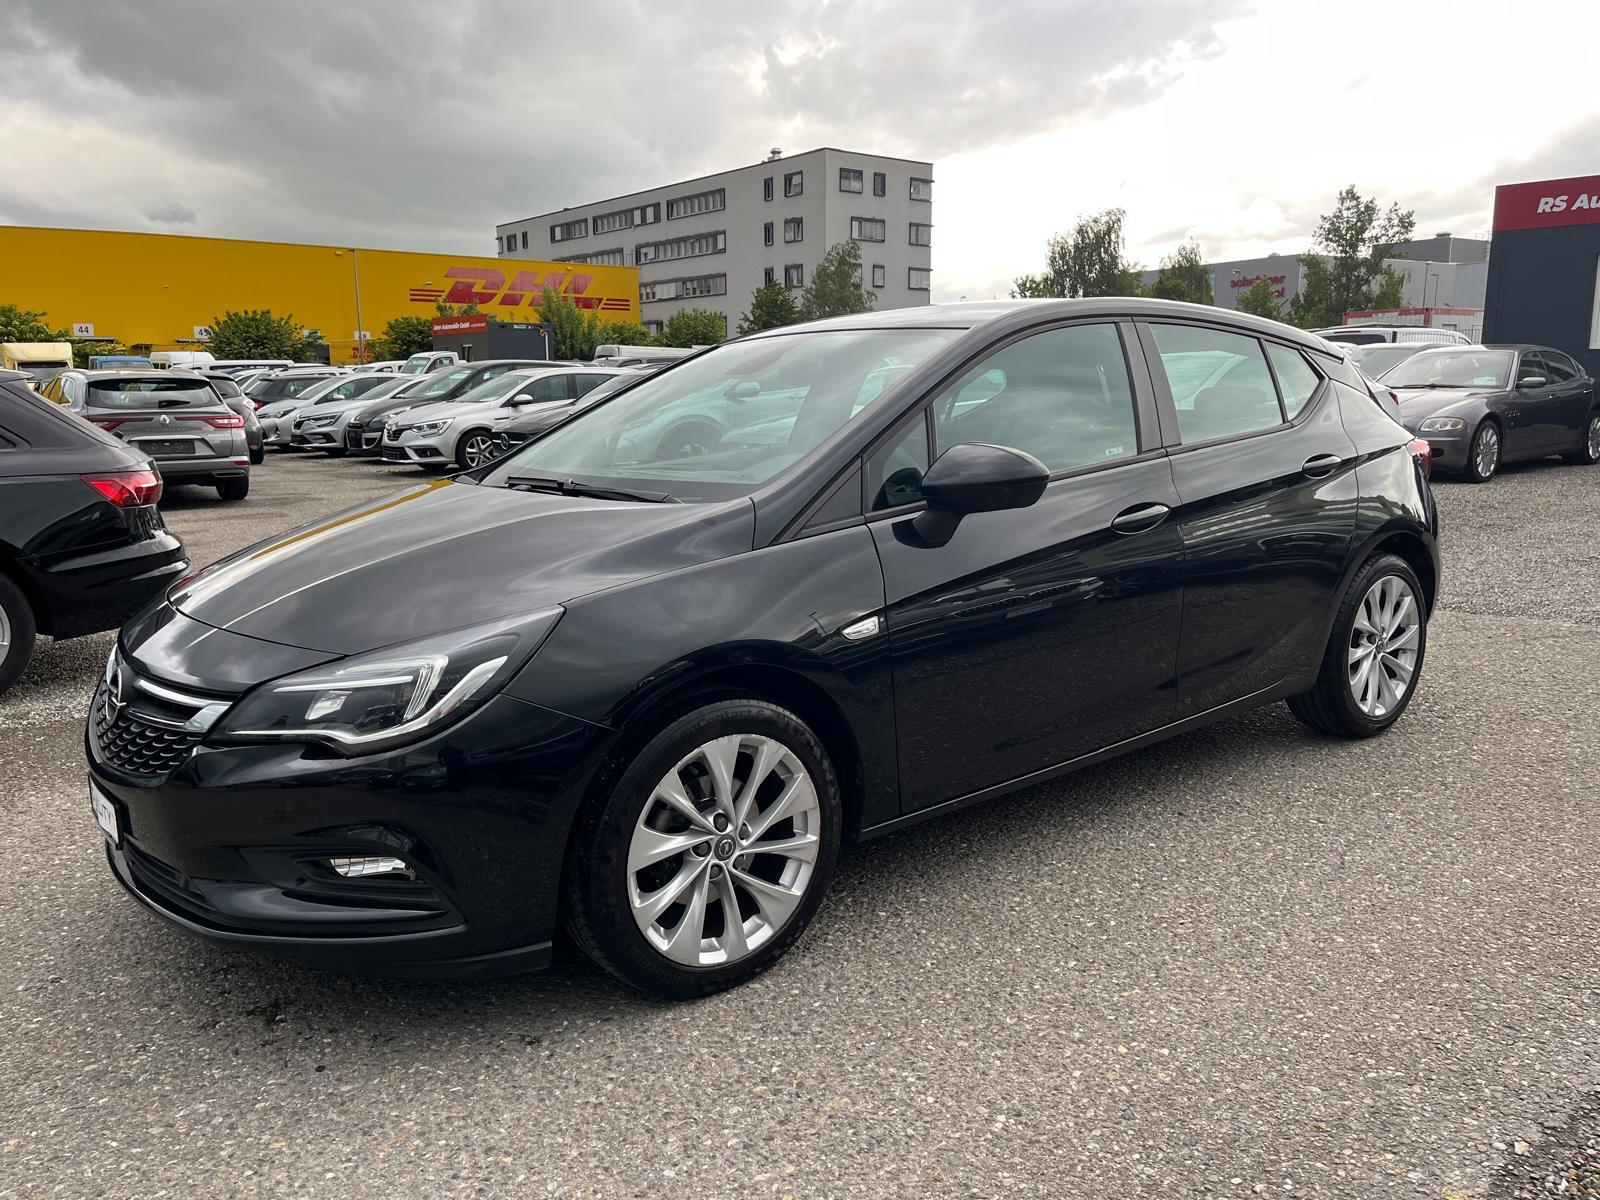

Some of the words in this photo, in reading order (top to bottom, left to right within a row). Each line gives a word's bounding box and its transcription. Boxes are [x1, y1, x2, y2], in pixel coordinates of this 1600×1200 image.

[1537, 195, 1568, 213] RS
[445, 267, 602, 310] DHL
[78, 326, 89, 334] 44
